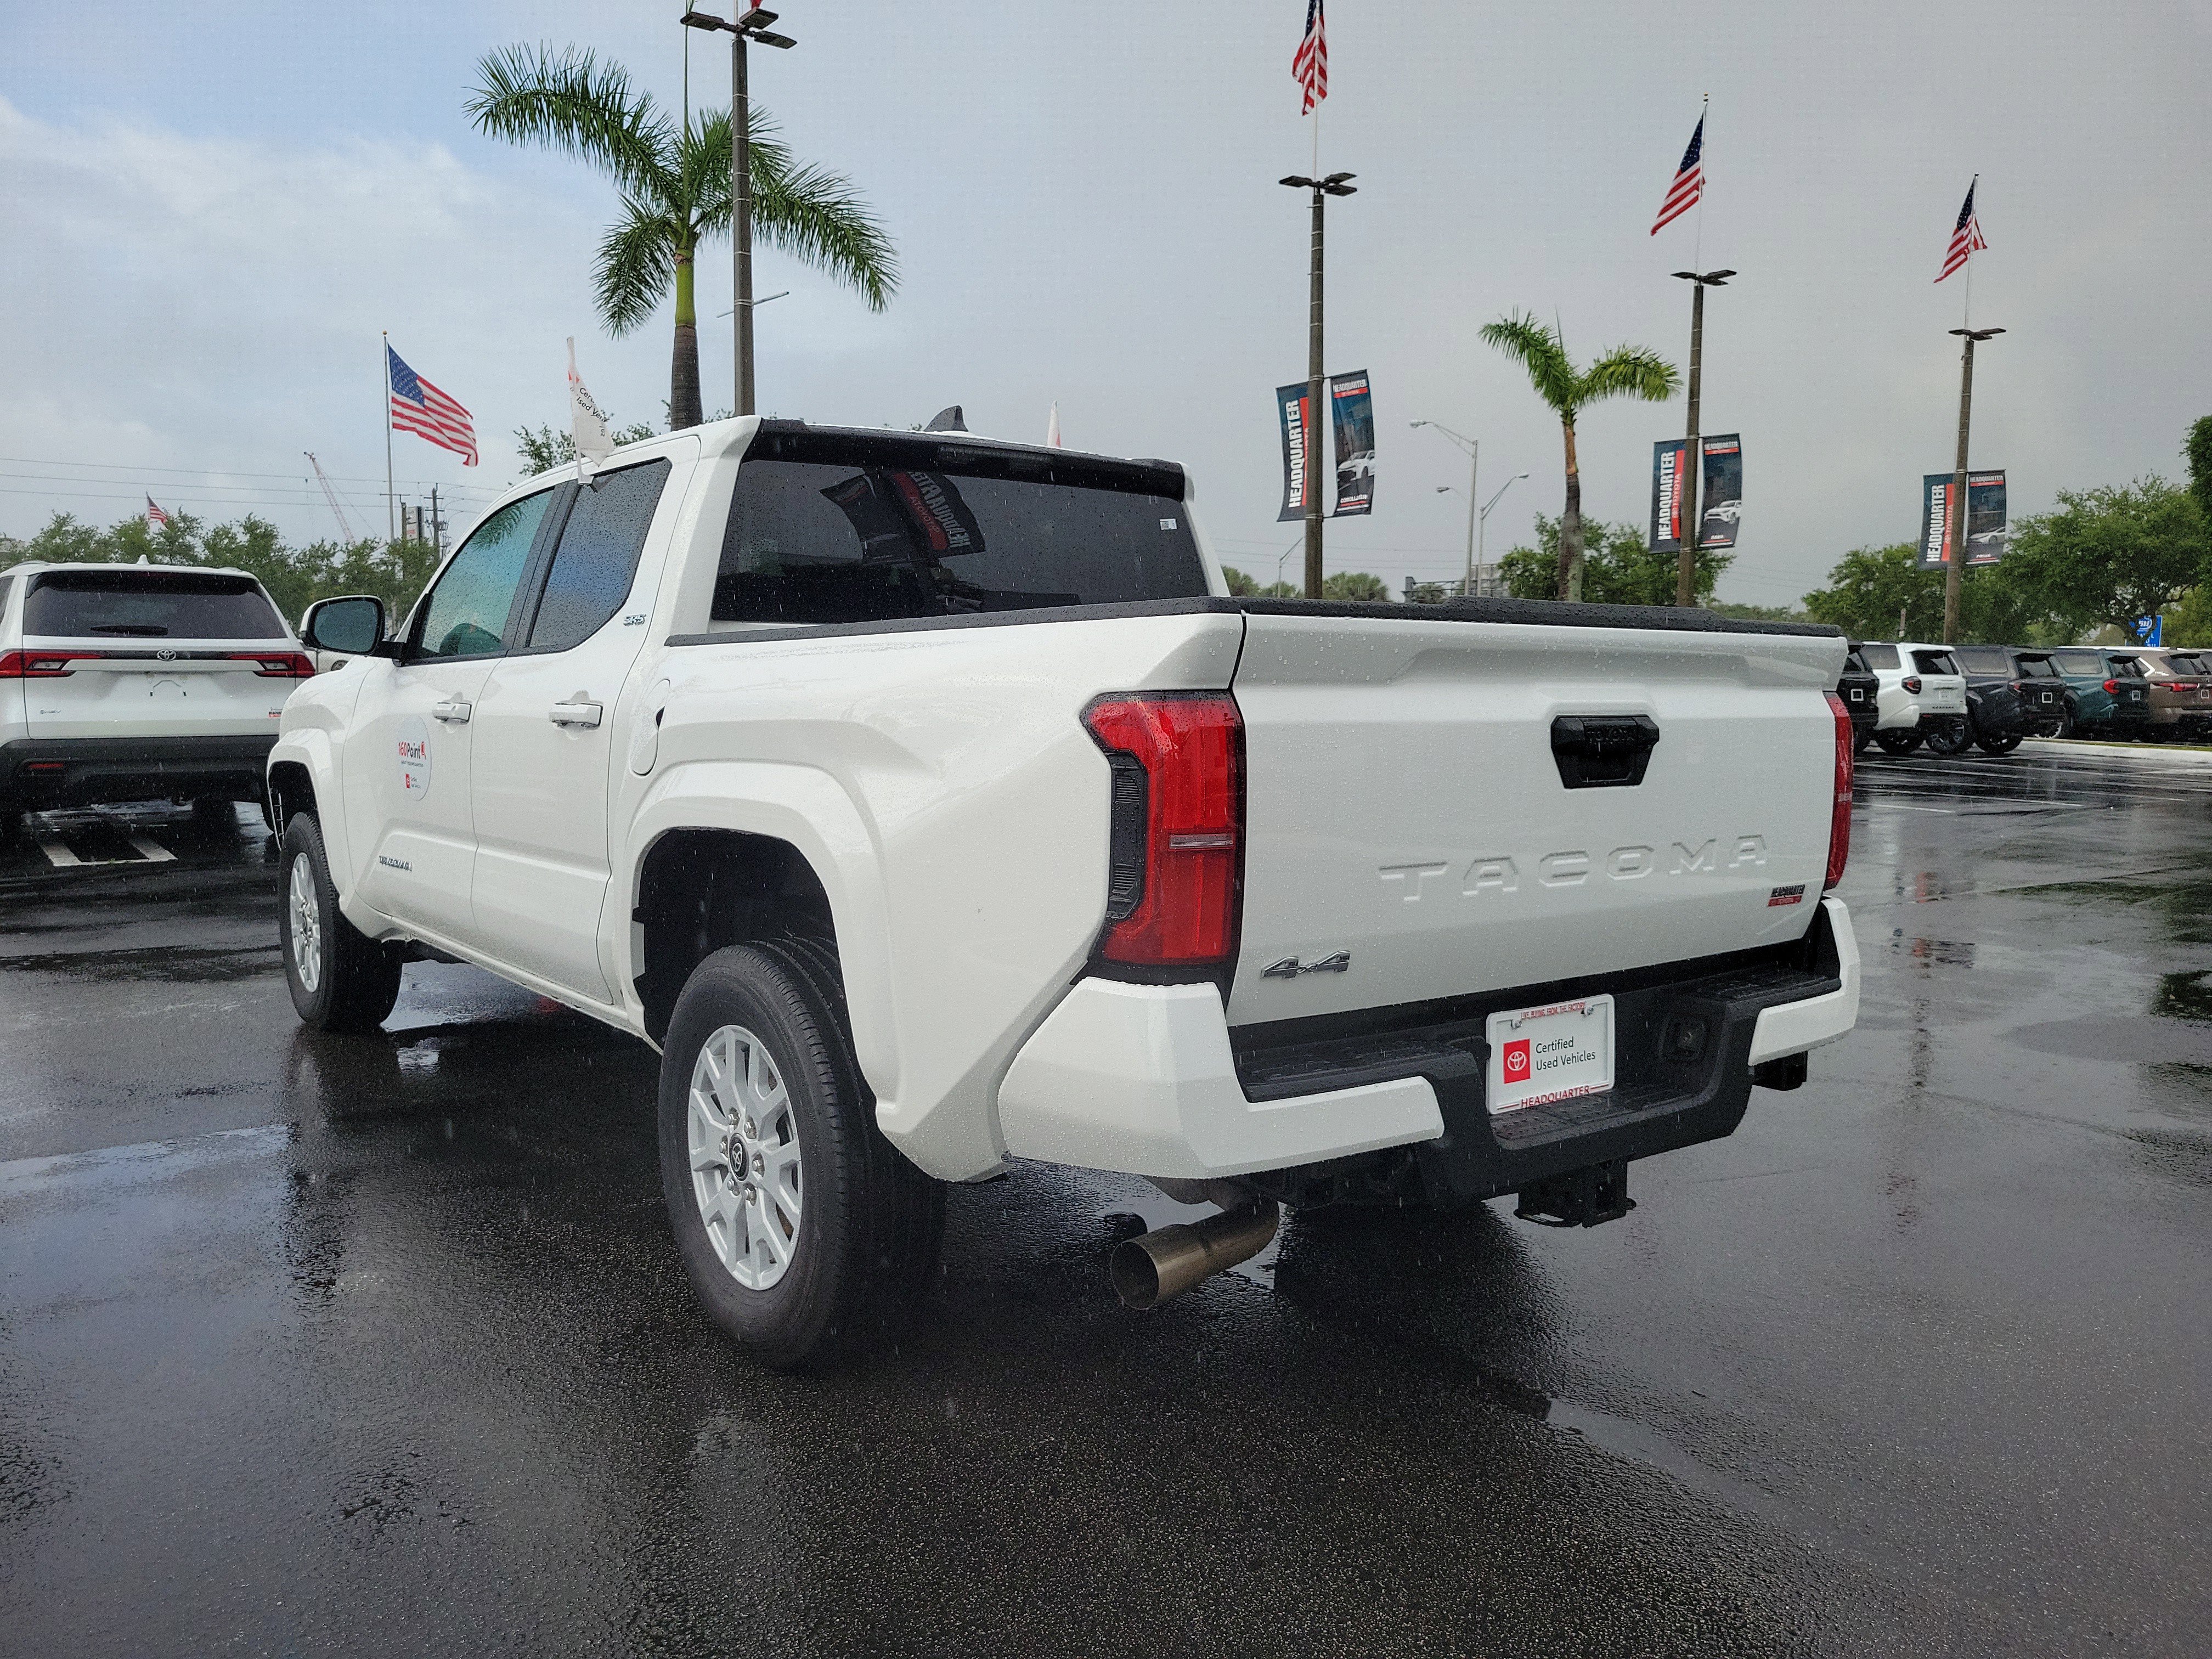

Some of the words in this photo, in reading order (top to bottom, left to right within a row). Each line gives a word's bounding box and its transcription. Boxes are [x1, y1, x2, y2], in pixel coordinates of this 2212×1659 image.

[1285, 399, 1305, 508] HEADQUARTER
[1657, 451, 1675, 540] HEADQUARTER
[1926, 484, 1945, 562] HEADQUARTER
[623, 614, 647, 627] SR5
[1379, 834, 1767, 901] TACOMA
[1770, 884, 1806, 898] HEADQUARTER
[1536, 1036, 1574, 1054] Certified
[1536, 1056, 1558, 1070] Used
[1560, 1050, 1595, 1065] Vehicles
[1521, 1085, 1590, 1108] HEADQUARTER
